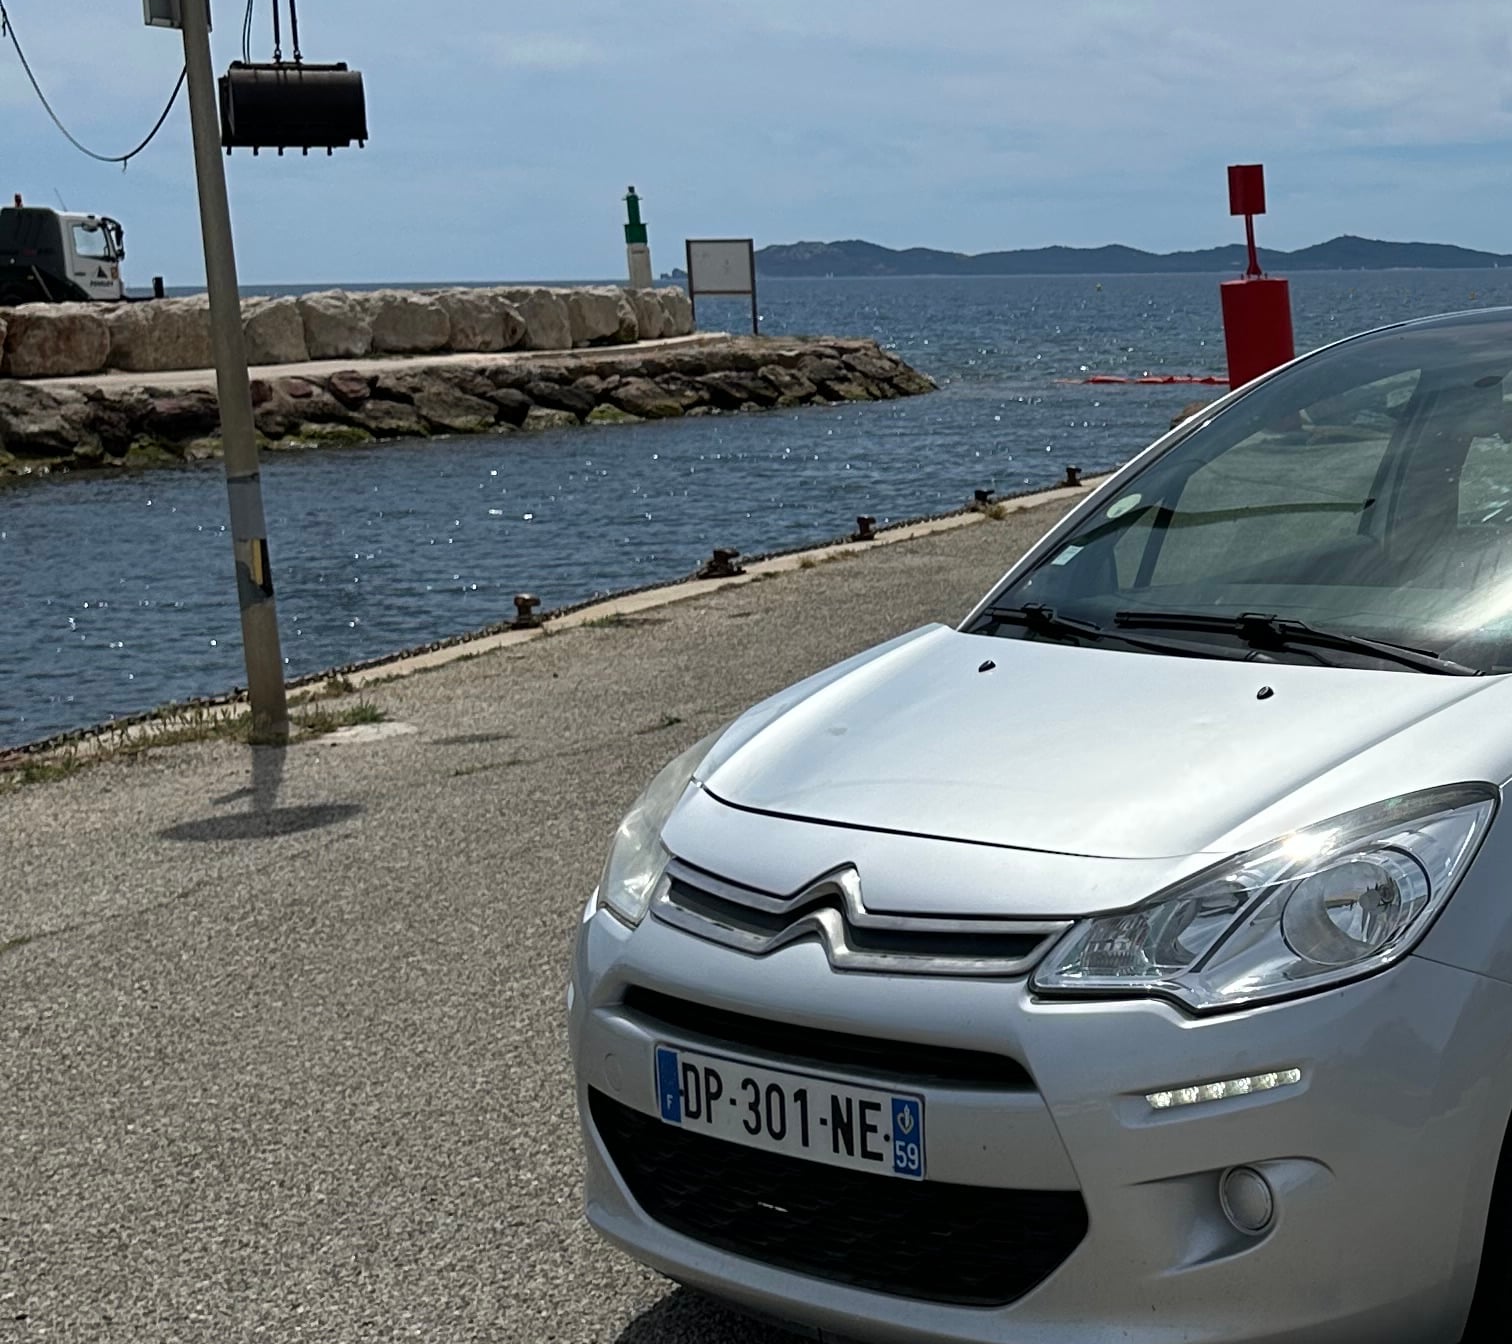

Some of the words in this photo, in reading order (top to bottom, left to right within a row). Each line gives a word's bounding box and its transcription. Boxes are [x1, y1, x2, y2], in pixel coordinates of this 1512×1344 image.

[666, 1094, 673, 1111] F
[682, 1062, 884, 1162] DP-301-NE
[895, 1140, 919, 1170] 59
